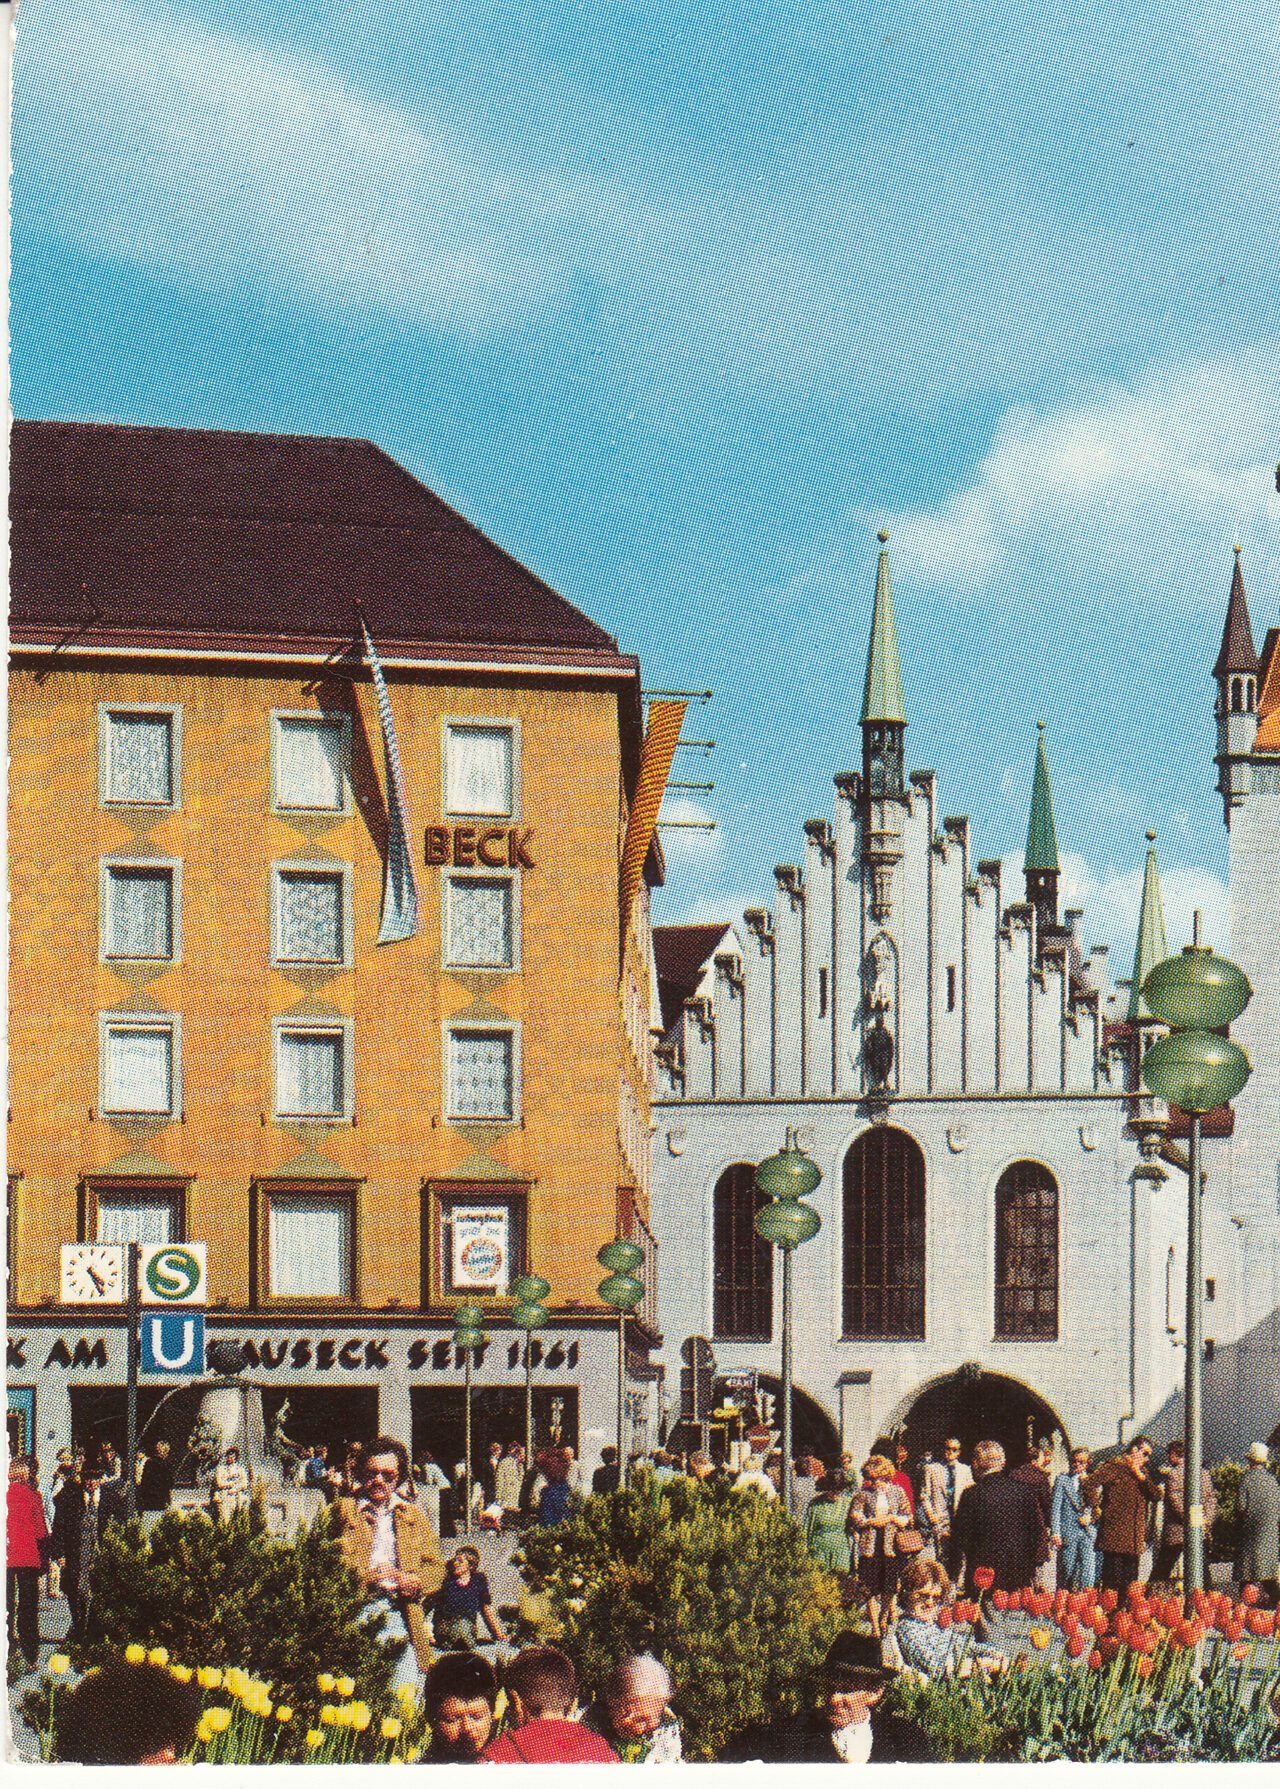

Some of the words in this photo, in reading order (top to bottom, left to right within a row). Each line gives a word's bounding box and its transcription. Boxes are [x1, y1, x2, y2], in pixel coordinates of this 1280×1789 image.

[424, 823, 536, 869] BECK
[155, 1251, 197, 1296] S
[44, 1337, 109, 1370] AM
[407, 1338, 491, 1371] SEIT
[506, 1339, 580, 1371] 1861
[151, 1318, 195, 1369] U
